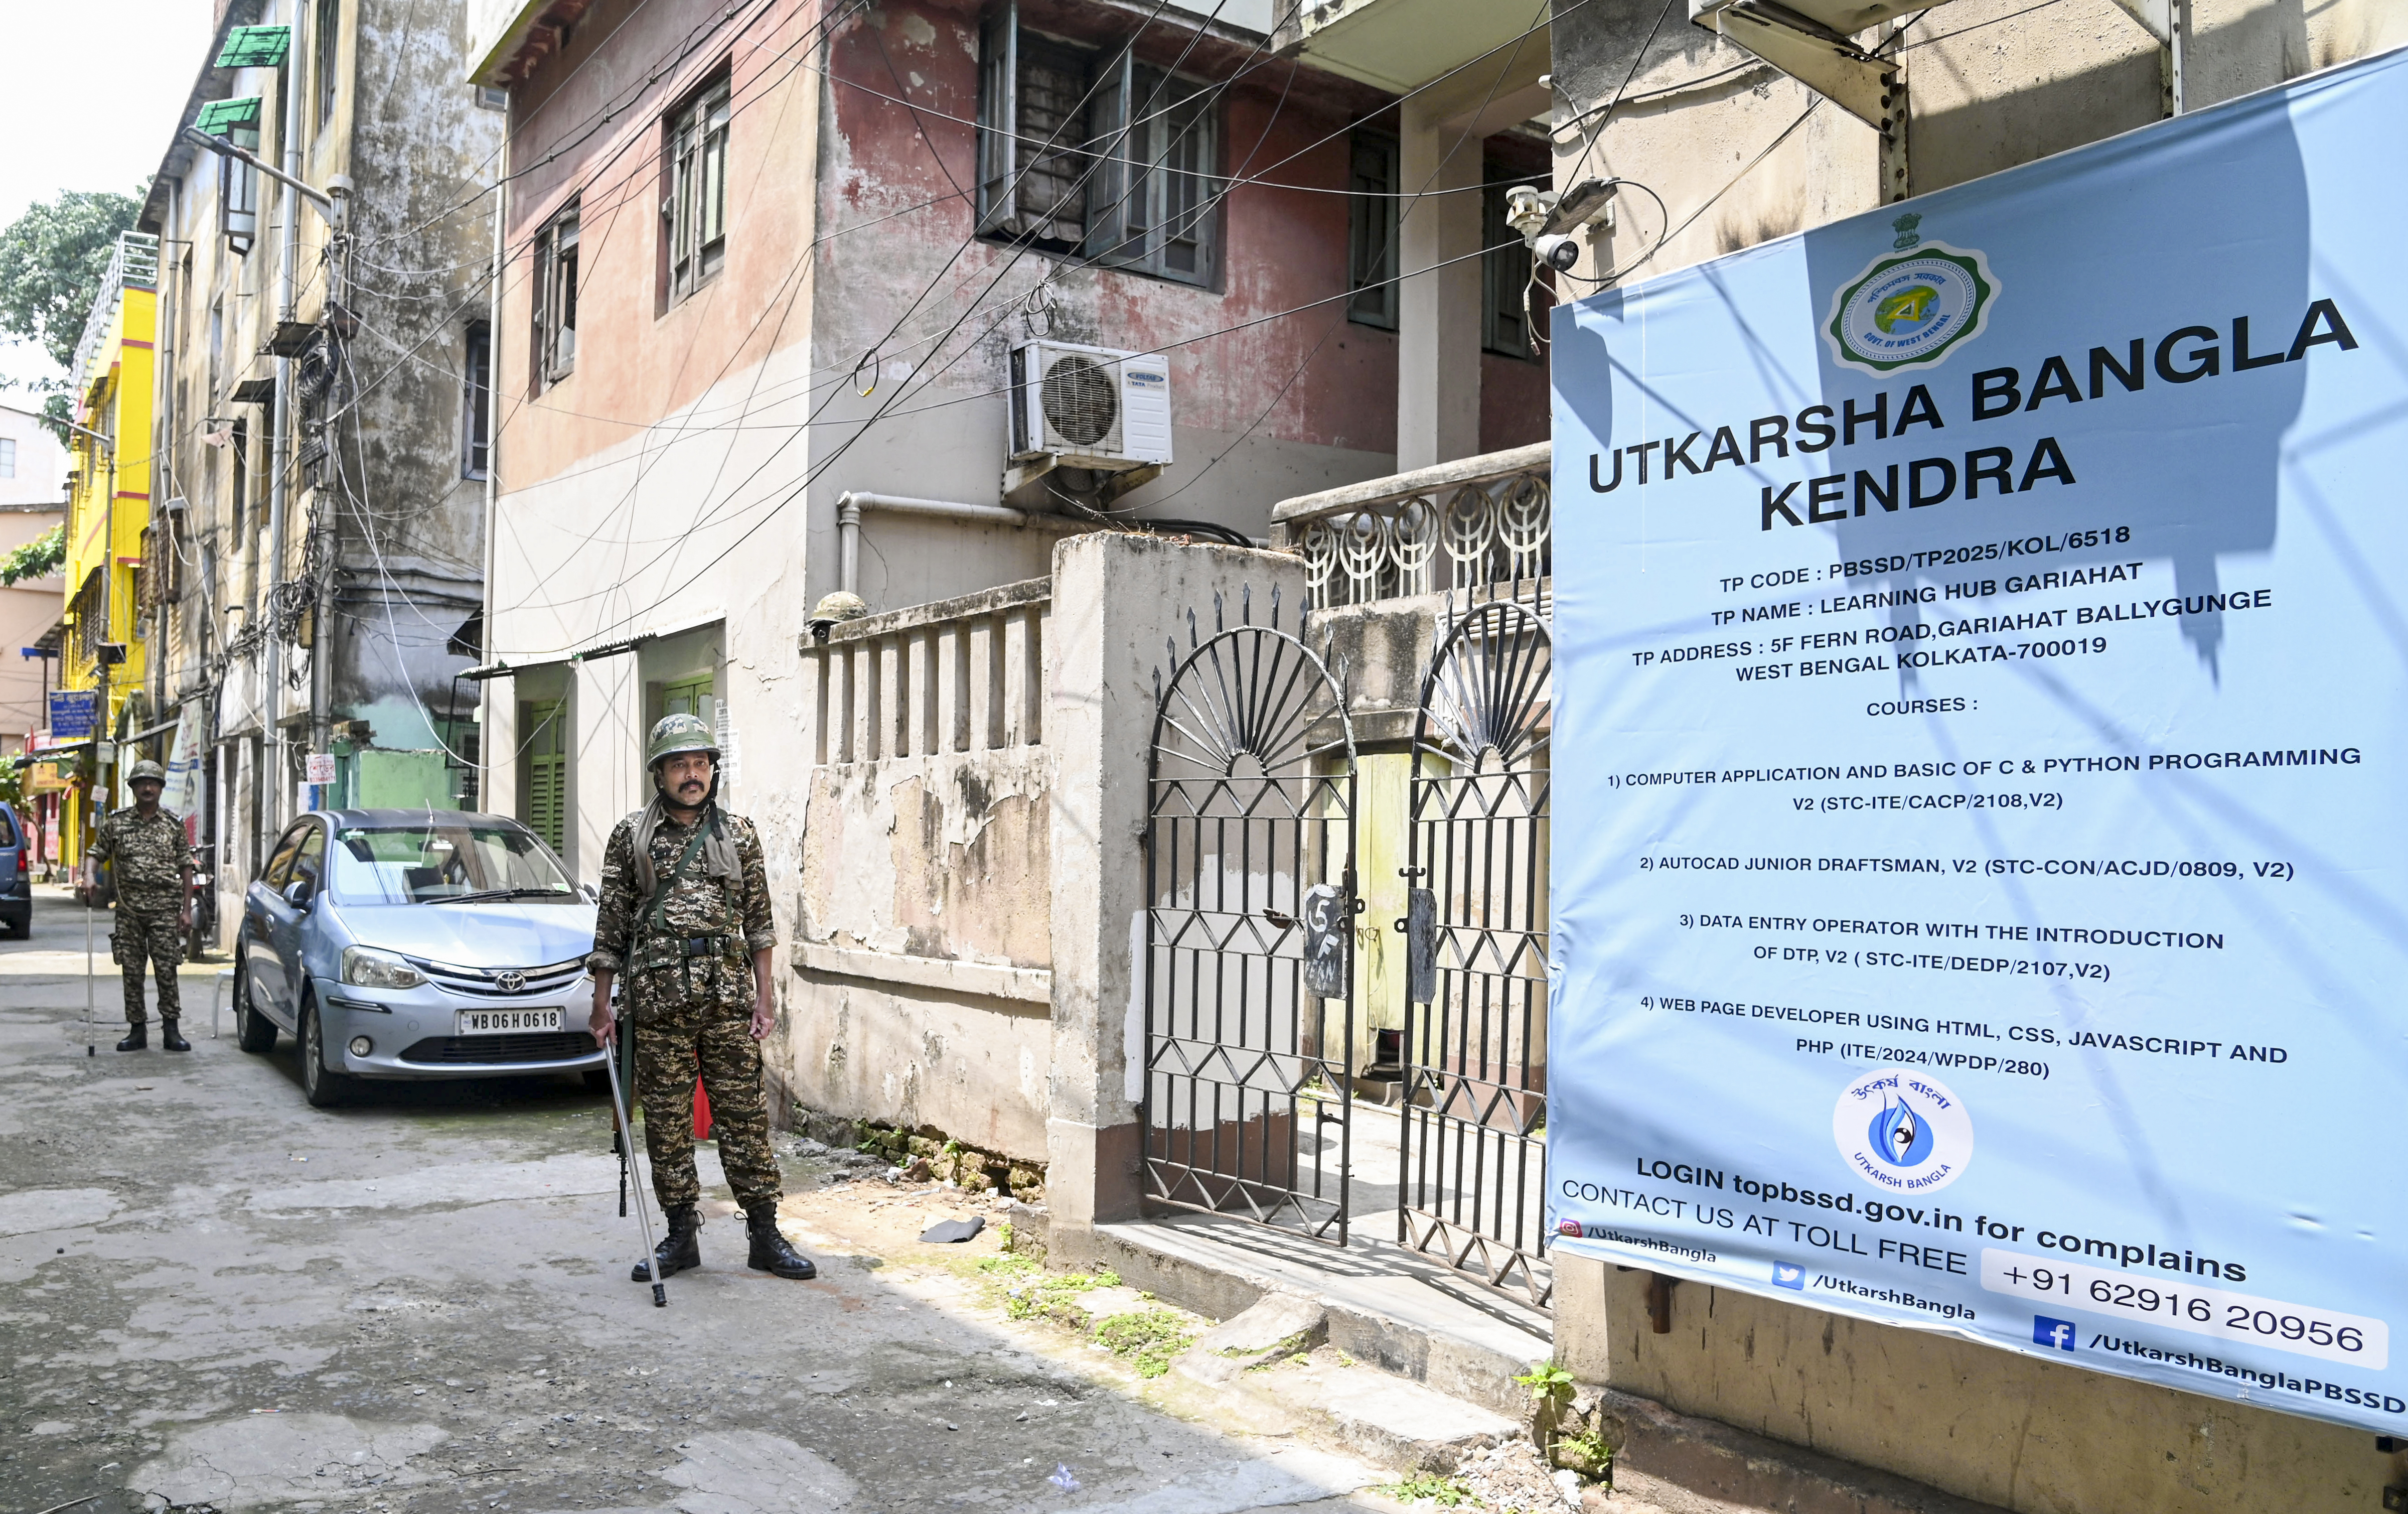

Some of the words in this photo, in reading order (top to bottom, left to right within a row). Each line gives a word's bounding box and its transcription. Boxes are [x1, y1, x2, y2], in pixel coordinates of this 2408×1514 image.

[1914, 273, 1946, 286] সরকার
[1864, 332, 1883, 346] GOVT.
[1897, 335, 1921, 347] WEST
[1922, 314, 1950, 338] BENGAL
[1590, 384, 1944, 493] UTKARSHA
[1972, 298, 2359, 422] BANGLA
[1762, 437, 2076, 531] KENDRA
[1720, 577, 1743, 592] TP
[1751, 568, 1809, 588] CODE
[1830, 526, 2130, 579] PBSSD/TP2025/KOL/6518
[1712, 611, 1735, 625] TP
[1743, 602, 1800, 622] NAME
[1822, 587, 1935, 613] LEARNING
[1945, 580, 1996, 600] HUB
[2005, 562, 2143, 593] GARIAHAT
[1632, 652, 1654, 665] TP
[1660, 641, 1751, 663] ADDRESS
[1771, 637, 1793, 652] 5F
[1801, 631, 1856, 650] FERN
[1866, 610, 2067, 644] ROAD,GARIAHAT
[2077, 589, 2272, 624] BALLYGUNGE
[1736, 663, 1793, 681] WEST
[1800, 656, 1889, 676] BENGAL
[1897, 637, 2106, 677] KOLKATA-700019
[1867, 698, 1965, 716] COURSES
[1608, 775, 1620, 789] 1)
[1626, 772, 1715, 785] COMPUTER
[1722, 767, 1839, 782] APPLICATION
[1847, 765, 1887, 778] AND
[1895, 762, 1955, 777] BASIC
[1964, 761, 1992, 775] OF
[1999, 761, 2013, 774] C
[2022, 760, 2035, 773] &
[2045, 756, 2139, 772] PYTHON
[2150, 748, 2360, 769] PROGRAMMING
[1793, 798, 1814, 810] V2
[1821, 793, 2062, 813] (STC-ITE/CACP/2108,V2)
[1640, 858, 1653, 871] 2)
[1660, 858, 1739, 869] AUTOCAD
[1745, 858, 1811, 870] JUNIOR
[1819, 859, 1944, 875] DRAFTSMAN,
[1952, 860, 1976, 873] V2
[1985, 860, 2243, 880] (STC-CON/ACJD/0809,
[2253, 862, 2293, 881] V2)
[1308, 899, 1330, 932] 5
[1680, 914, 1693, 929] 3)
[1701, 915, 1742, 928] DATA
[1749, 917, 1807, 930] ENTRY
[1813, 919, 1918, 935] OPERATOR
[1926, 923, 1978, 938] WITH
[1986, 926, 2028, 940] THE
[2037, 928, 2222, 949] INTRODUCTION
[1754, 946, 1777, 958] OF
[1784, 948, 1819, 964] DTP,
[1826, 950, 1847, 963] V2
[1867, 952, 2110, 982] STC-ITE/DEDP/2107,V2)
[472, 1014, 488, 1029] WB
[493, 1014, 508, 1028] 06
[513, 1013, 519, 1028] H
[524, 1012, 557, 1027] 0618
[1641, 997, 1653, 1011] 4)
[1660, 998, 1695, 1011] WEB
[1702, 1001, 1745, 1016] PAGE
[1752, 1005, 1859, 1026] DEVELOPER
[1868, 1015, 1928, 1032] USING
[1937, 1020, 2000, 1041] HTML,
[2009, 1026, 2060, 1046] CSS,
[2069, 1032, 2221, 1057] JAVASCRIPT
[2229, 1045, 2287, 1063] AND
[1797, 1039, 1833, 1053] PHP
[1841, 1043, 2049, 1080] (ITE/2024/WPDP/280)
[1851, 1074, 1899, 1100] উৎকর্ষ
[1909, 1079, 1951, 1110] বাংলা
[1854, 1152, 1902, 1187] UTKARSH
[1907, 1164, 1951, 1188] BANGLA
[1638, 1158, 1723, 1189] LOGIN
[1733, 1175, 1962, 1231] topbssd.gov.in
[1975, 1216, 2024, 1242] for
[2037, 1231, 2246, 1281] complains
[1588, 1226, 1717, 1263] /UtkarshBangla
[1563, 1180, 1687, 1218] CONTACT
[1697, 1204, 1733, 1228] US
[1743, 1214, 1779, 1236] AT
[1788, 1221, 1867, 1255] TOLL
[1879, 1239, 1967, 1275] FREE
[2004, 1267, 2069, 1294] +91
[2090, 1280, 2210, 1321] 62916
[2226, 1306, 2362, 1351] 20956
[1813, 1275, 1975, 1320] /UtkarshBangla
[2089, 1334, 2405, 1413] /UtkarshBanglaPBSSD
